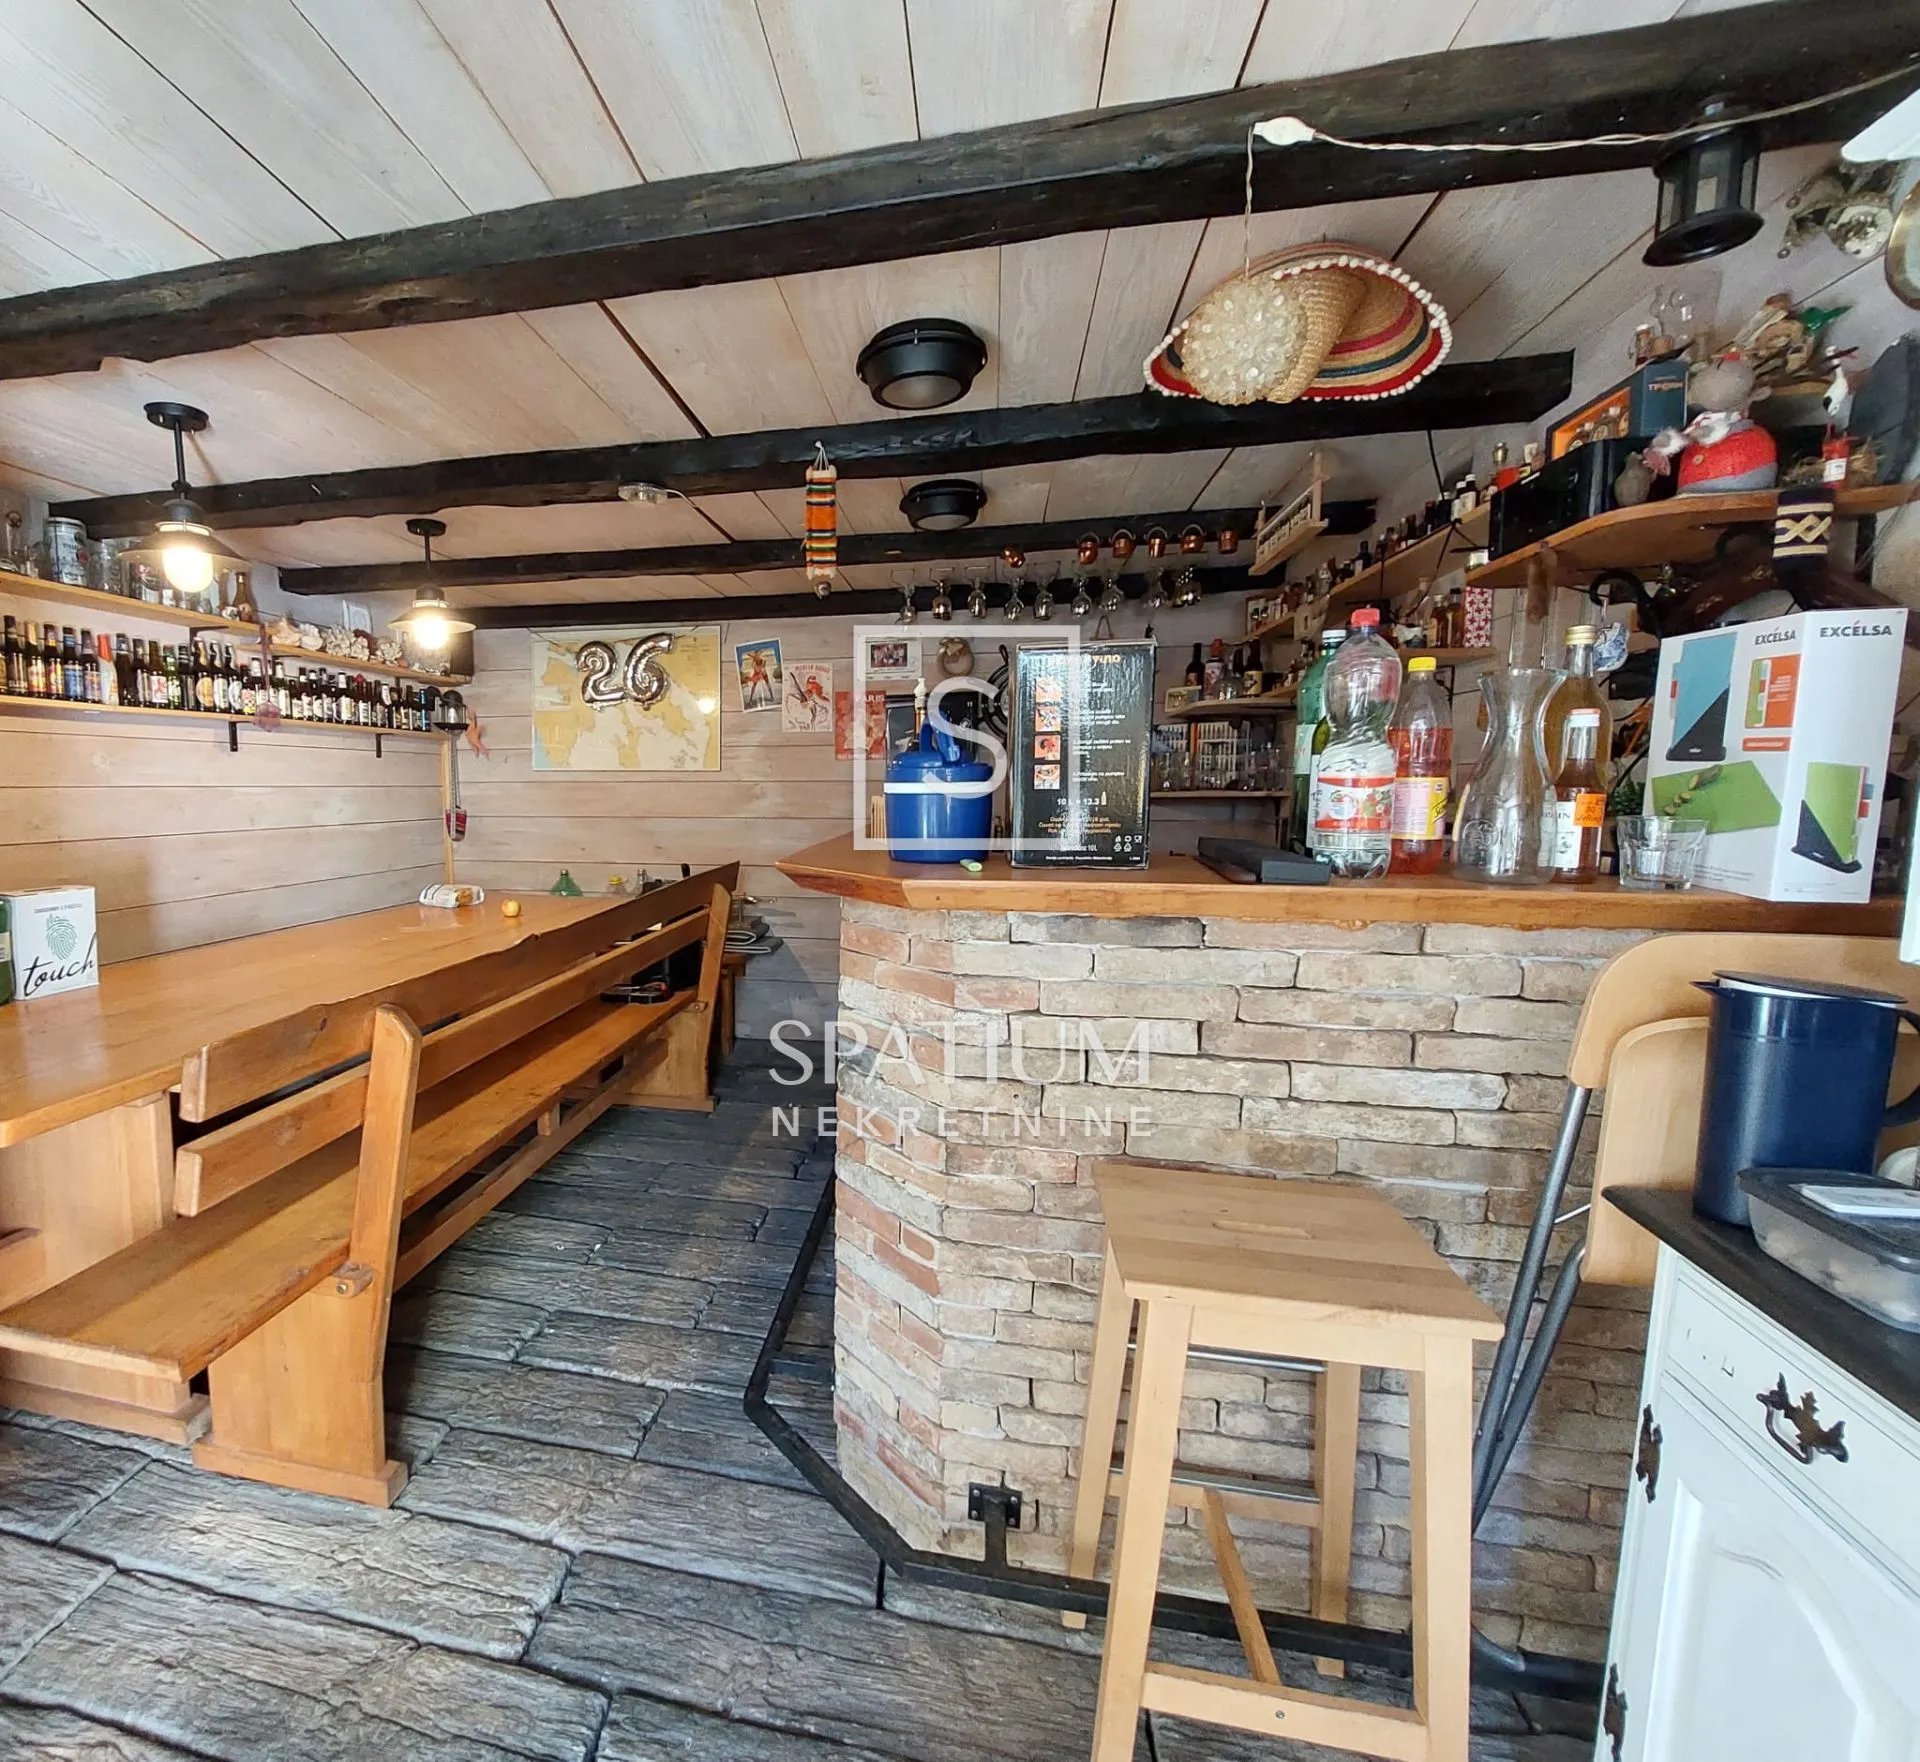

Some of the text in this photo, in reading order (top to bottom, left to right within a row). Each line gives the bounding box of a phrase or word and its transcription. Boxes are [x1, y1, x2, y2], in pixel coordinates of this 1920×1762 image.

[1754, 626, 1796, 645] EXCÉLSA
[1819, 621, 1893, 638] EXCÉLSA
[23, 931, 97, 997] touch
